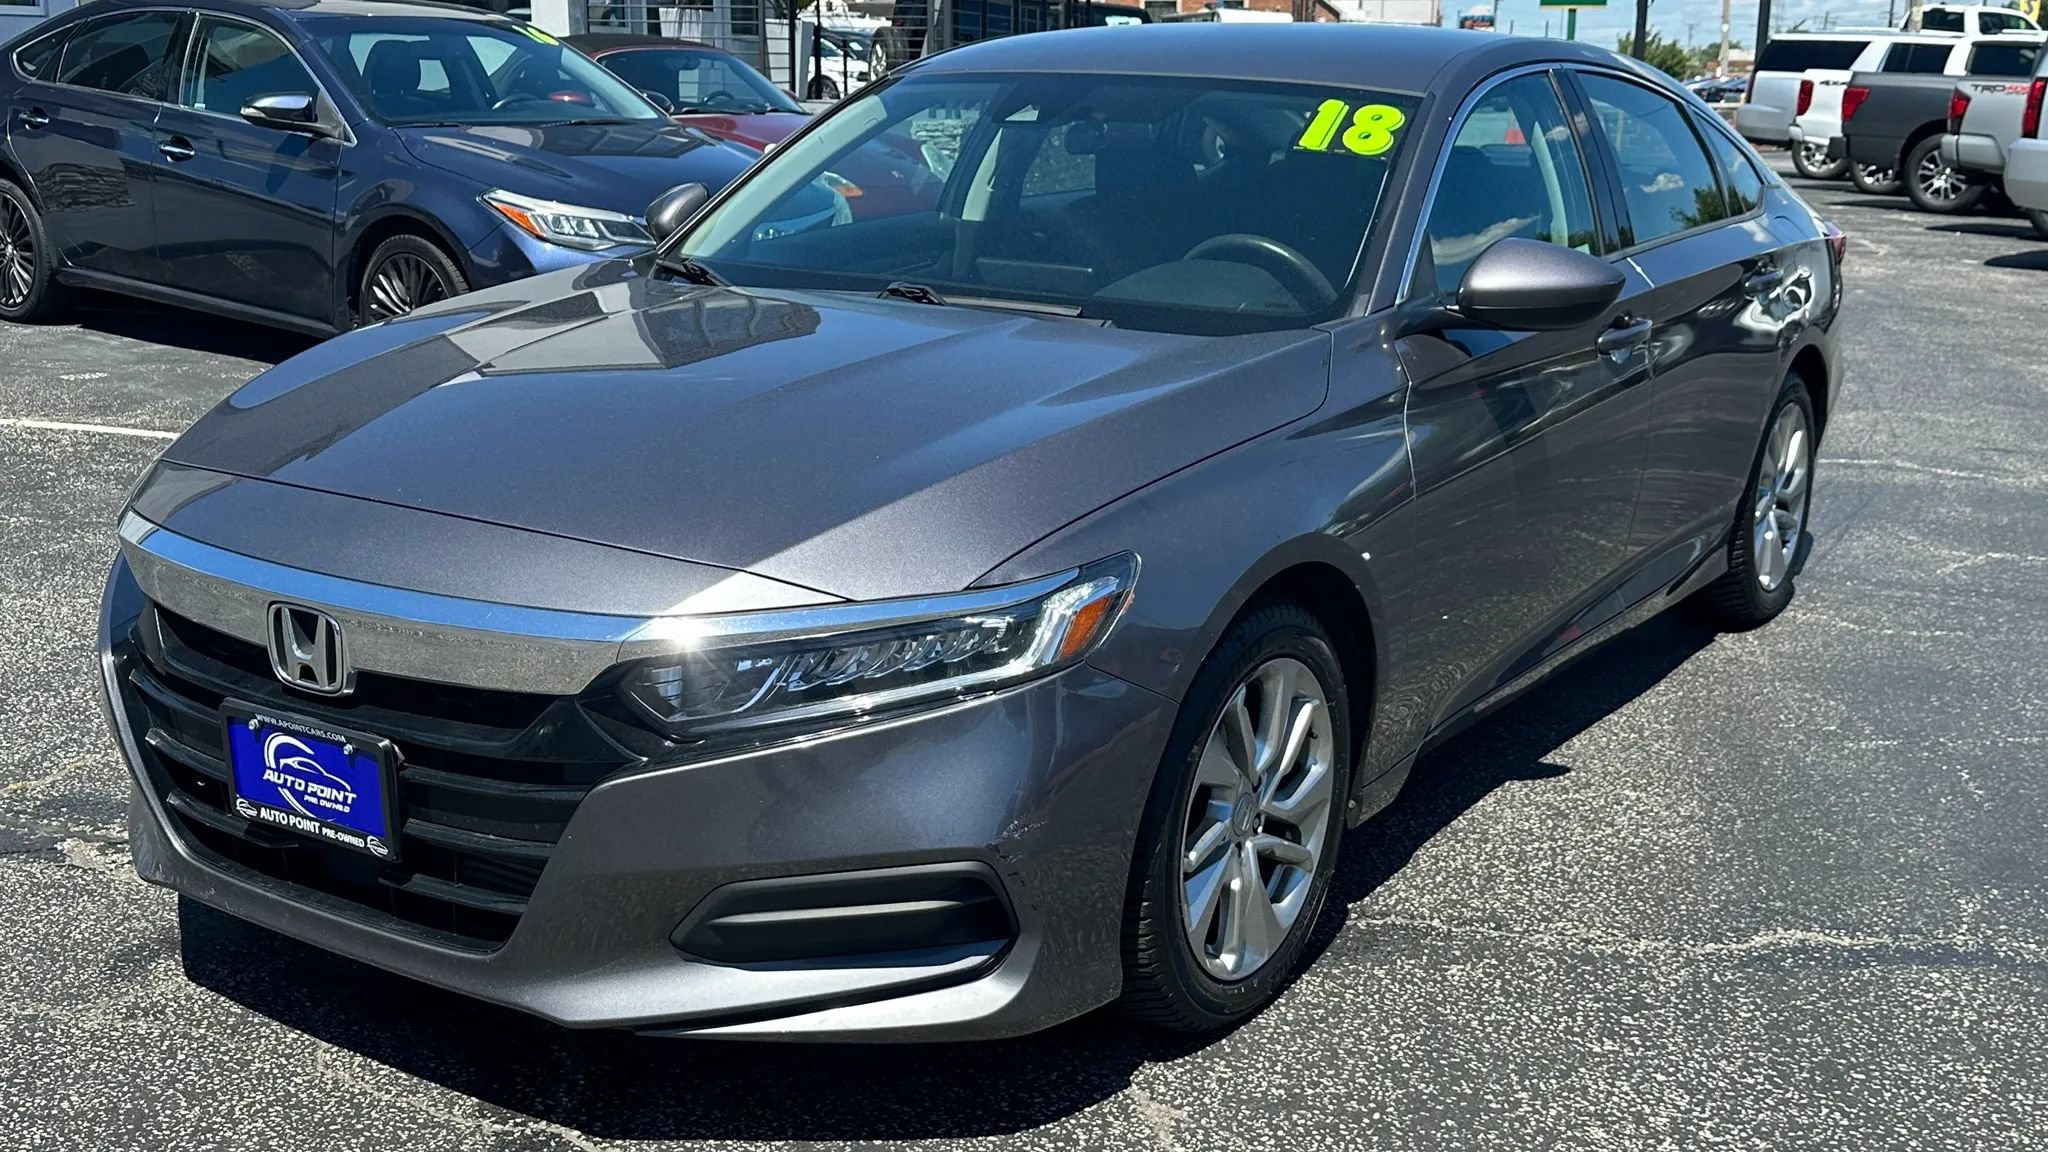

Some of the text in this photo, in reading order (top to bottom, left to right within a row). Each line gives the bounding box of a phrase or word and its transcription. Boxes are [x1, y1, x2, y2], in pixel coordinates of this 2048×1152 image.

[1298, 99, 1405, 155] 18
[255, 713, 346, 743] WWW.APOINTCARS.COM
[263, 769, 357, 804] AUTO POINT
[303, 795, 350, 813] PRE OWNED
[260, 807, 288, 825] AUTO
[289, 814, 320, 834] POINT
[322, 827, 365, 847] PRE-OWNED
